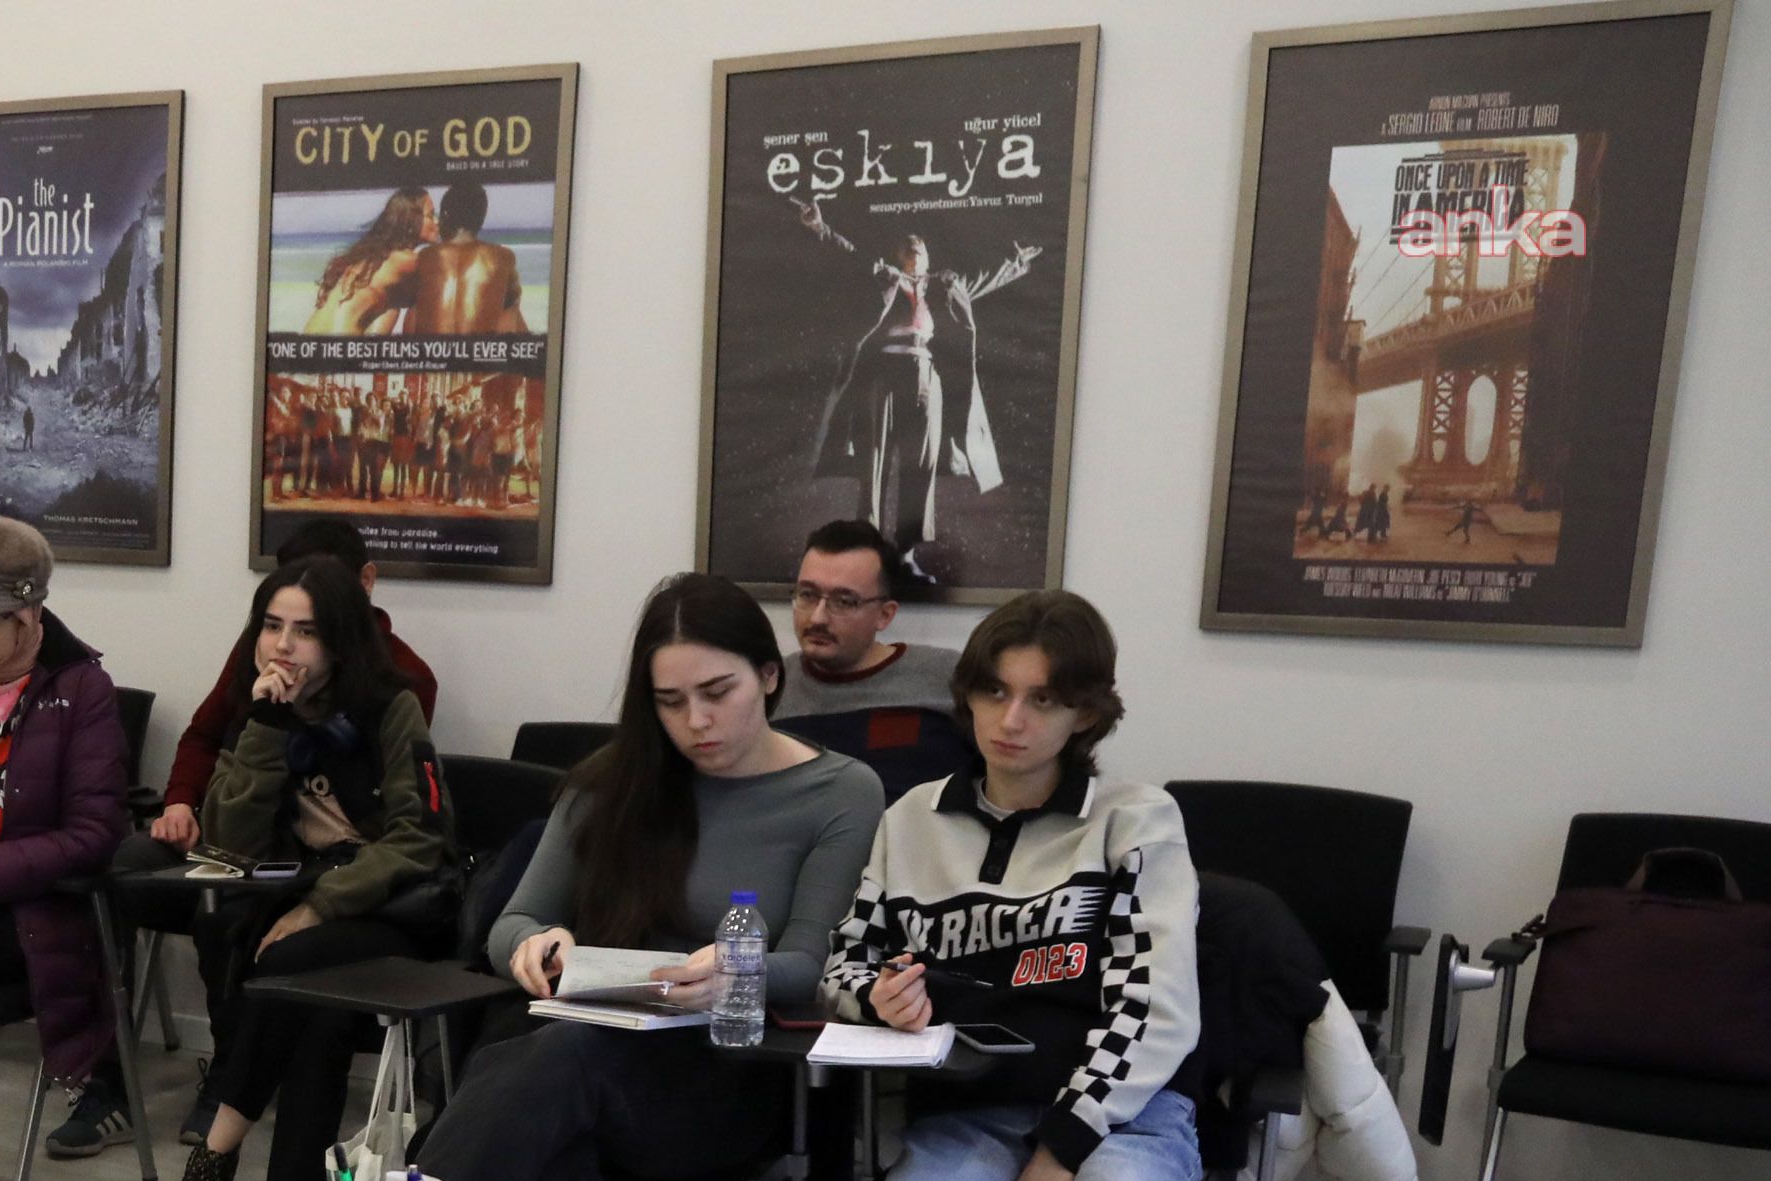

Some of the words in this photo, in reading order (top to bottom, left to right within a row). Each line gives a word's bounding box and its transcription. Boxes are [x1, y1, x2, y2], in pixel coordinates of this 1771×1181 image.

[964, 117, 998, 134] uğur
[1003, 113, 1041, 132] yücel
[1388, 113, 1423, 135] SERGIO
[1424, 111, 1456, 133] LEONE
[1477, 107, 1515, 131] ROBERT
[1517, 105, 1532, 128] DE
[1533, 104, 1559, 127] NIRO
[295, 123, 384, 165] CITY
[394, 129, 428, 158] OF
[443, 116, 531, 158] GOD
[763, 133, 800, 149] şener
[804, 131, 828, 146] şen
[767, 129, 1041, 201] eşkıya
[1395, 163, 1433, 192] ONCE
[1436, 162, 1475, 189] UPON
[1480, 161, 1491, 188] A
[1495, 159, 1530, 187] TIME
[34, 178, 55, 207] the
[1392, 193, 1412, 226] IN
[300, 342, 317, 358] OF
[321, 342, 343, 358] THE
[348, 342, 378, 358] BEST
[382, 341, 420, 358] FILMS
[424, 341, 469, 358] YOU'LL
[473, 342, 507, 359] EVER
[43, 515, 76, 523] THOMAS
[365, 541, 388, 550] ything
[455, 543, 499, 554] everything
[936, 886, 1106, 960] RACER
[1011, 942, 1088, 987] 0123
